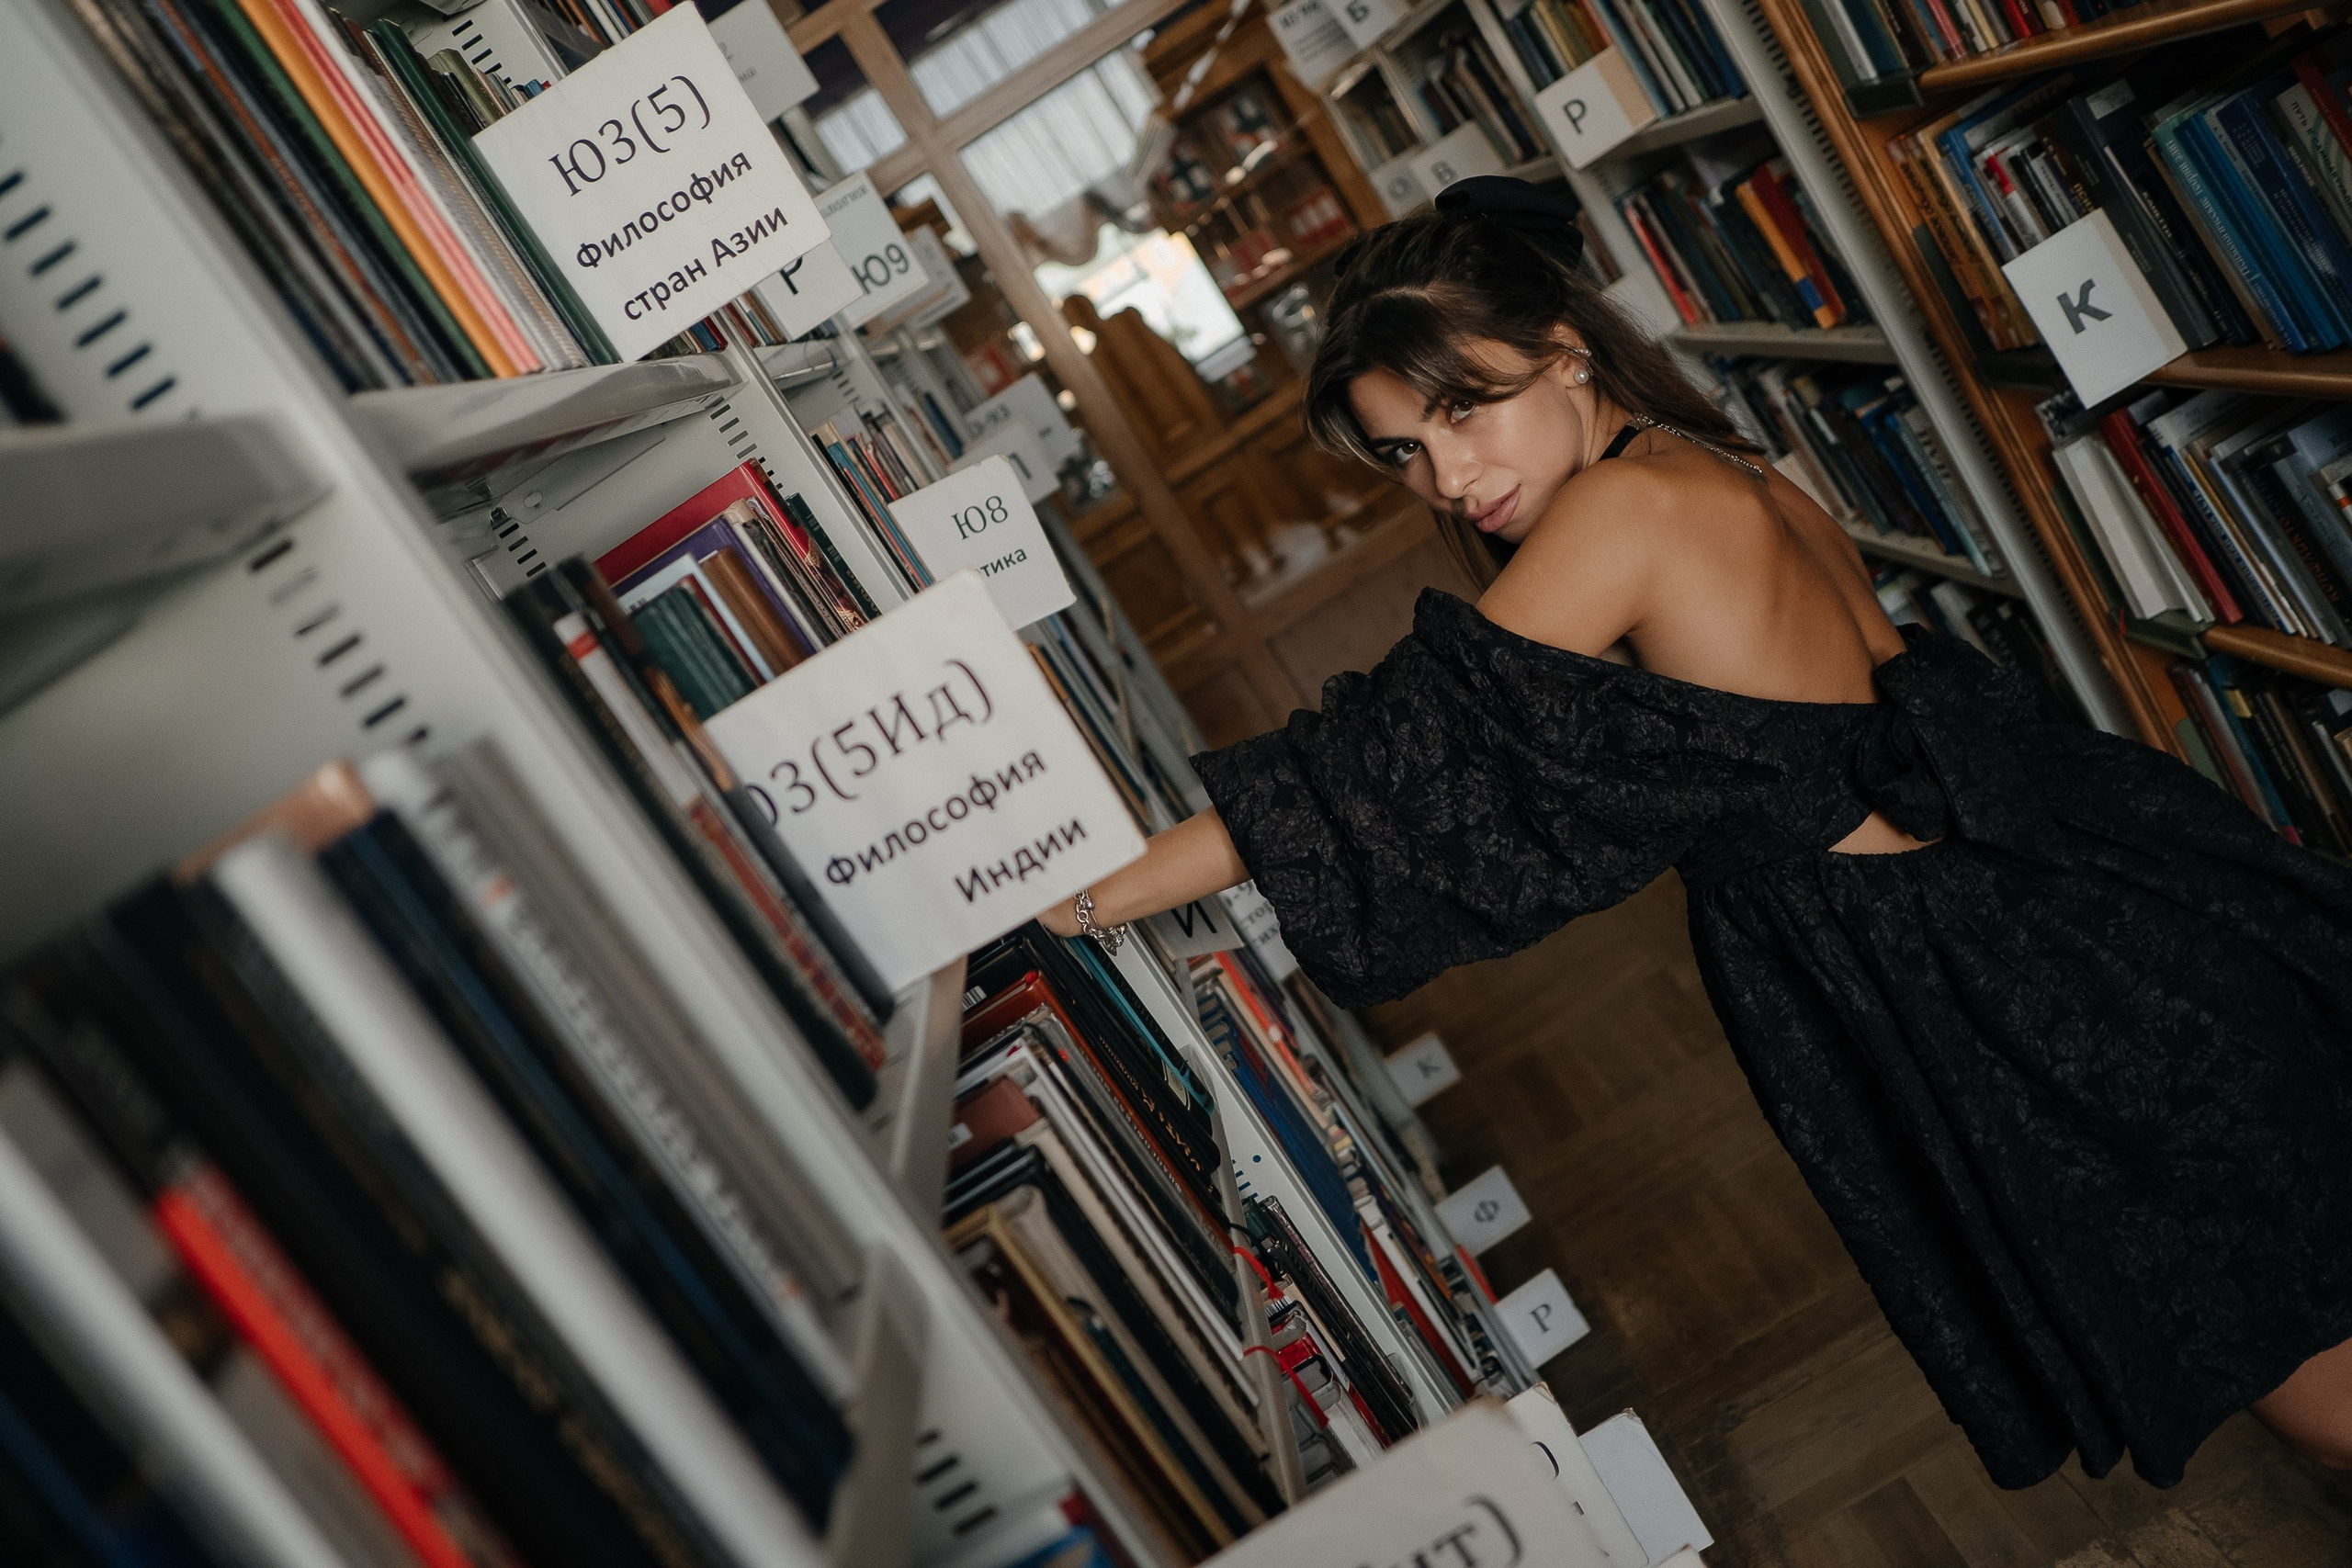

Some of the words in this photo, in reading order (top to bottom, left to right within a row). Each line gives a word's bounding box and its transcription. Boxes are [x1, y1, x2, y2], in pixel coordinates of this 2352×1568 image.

[548, 74, 712, 197] ЮЗ(5)
[1562, 98, 1589, 135] Р
[576, 151, 752, 270] Философия
[623, 257, 709, 321] стран
[711, 205, 789, 268] Азии
[851, 243, 910, 295] Ю9
[2056, 277, 2112, 334] К
[950, 495, 1009, 541] Ю8
[978, 547, 1028, 578] тика
[825, 750, 1048, 888] Философия
[952, 816, 1091, 907] Индии
[1170, 900, 1217, 939] И
[1528, 1303, 1554, 1335] Р
